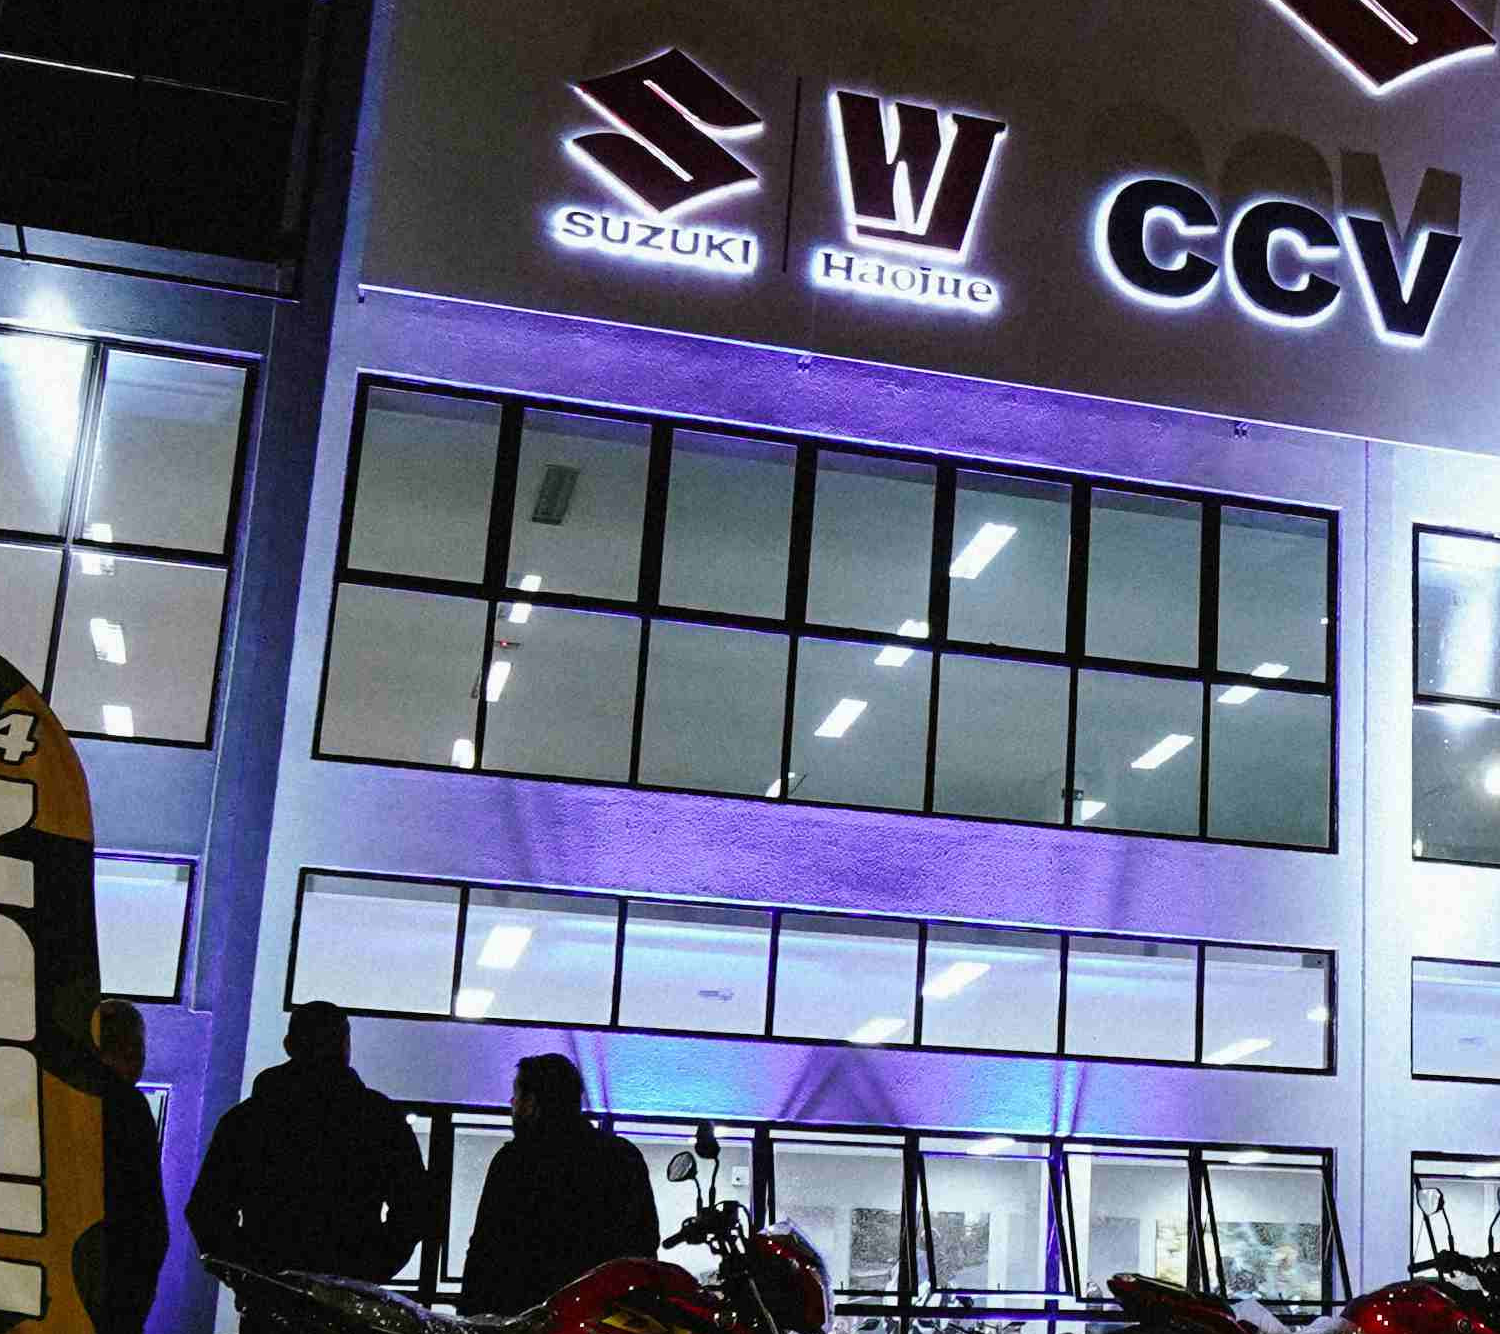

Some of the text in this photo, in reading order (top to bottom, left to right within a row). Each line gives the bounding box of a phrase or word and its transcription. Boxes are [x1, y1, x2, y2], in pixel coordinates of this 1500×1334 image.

[562, 211, 752, 265] SUZUKI
[1107, 179, 1461, 337] CCV
[821, 252, 993, 303] Haojue
